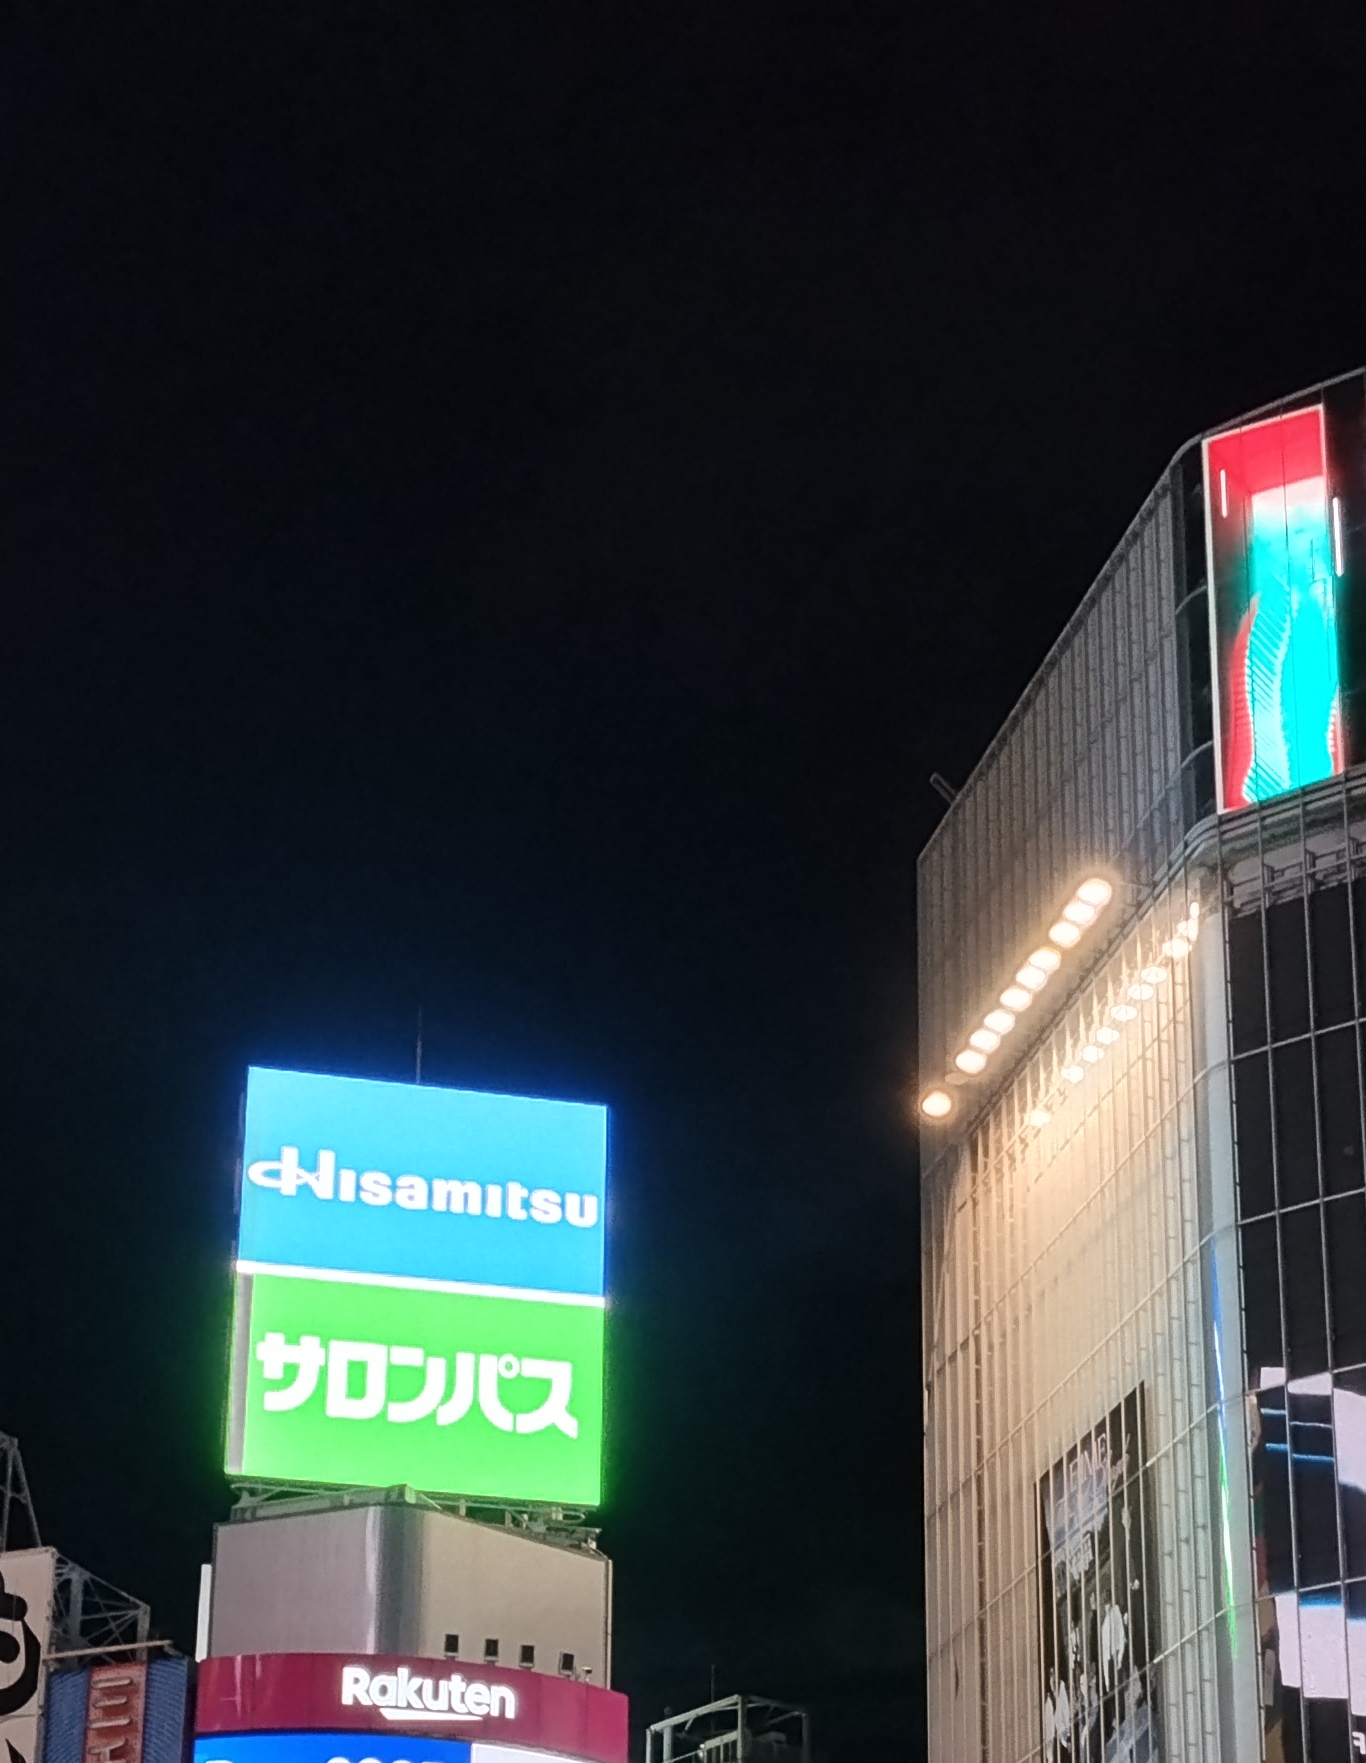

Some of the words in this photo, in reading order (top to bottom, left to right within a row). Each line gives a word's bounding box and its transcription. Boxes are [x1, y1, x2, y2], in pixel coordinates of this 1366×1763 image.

[247, 1146, 597, 1227] Hisamitsu
[256, 1332, 579, 1438] サロンパス
[341, 1667, 515, 1719] Rakuten
